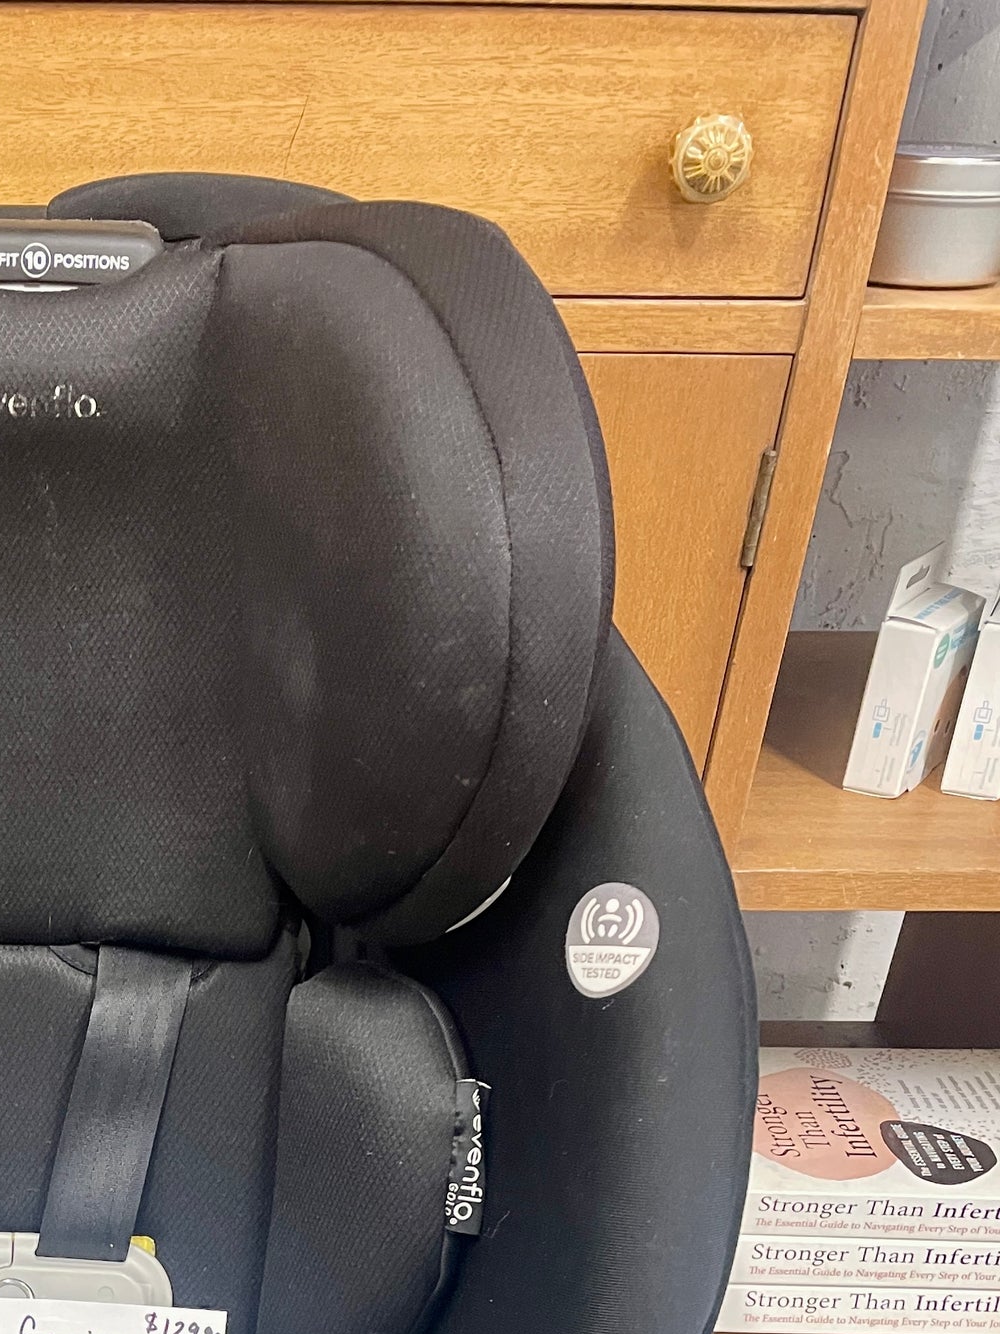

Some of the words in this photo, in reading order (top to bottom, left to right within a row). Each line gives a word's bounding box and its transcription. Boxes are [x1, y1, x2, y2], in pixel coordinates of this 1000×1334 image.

[27, 251, 46, 271] 10
[53, 253, 130, 271] POSITIONS
[595, 953, 641, 966] IMPACT
[581, 967, 621, 980] TESTED
[810, 1075, 878, 1158] Infertility
[795, 1111, 831, 1149] Than
[445, 1182, 460, 1216] GOLD
[758, 1195, 858, 1219] Stronger
[866, 1199, 924, 1217] Than
[755, 1218, 772, 1227] The
[775, 1218, 817, 1228] Essential
[819, 1220, 849, 1229] Guide
[863, 1221, 915, 1234] Navigating
[917, 1223, 945, 1235] Every
[949, 1224, 968, 1236] Step
[970, 1226, 983, 1234] of
[751, 1243, 850, 1267] Stronger
[858, 1246, 915, 1264] Than
[749, 1266, 766, 1275] The
[768, 1266, 810, 1276] Essential
[812, 1267, 842, 1277] Guide
[843, 1269, 853, 1278] to
[855, 1269, 907, 1281] Navigating
[909, 1271, 936, 1282] Every
[938, 1271, 959, 1283] Step
[961, 1272, 973, 1281] of
[974, 1272, 996, 1281] Your
[745, 1290, 842, 1314] Stronger
[849, 1293, 906, 1310] Than
[744, 1313, 760, 1322] The
[762, 1313, 803, 1323] Essential
[805, 1315, 835, 1325] Guide
[837, 1317, 846, 1325] to
[848, 1316, 899, 1328] Navigating
[901, 1317, 928, 1329] Every
[930, 1318, 950, 1329] Step
[953, 1318, 966, 1327] of
[965, 1319, 987, 1328] Your
